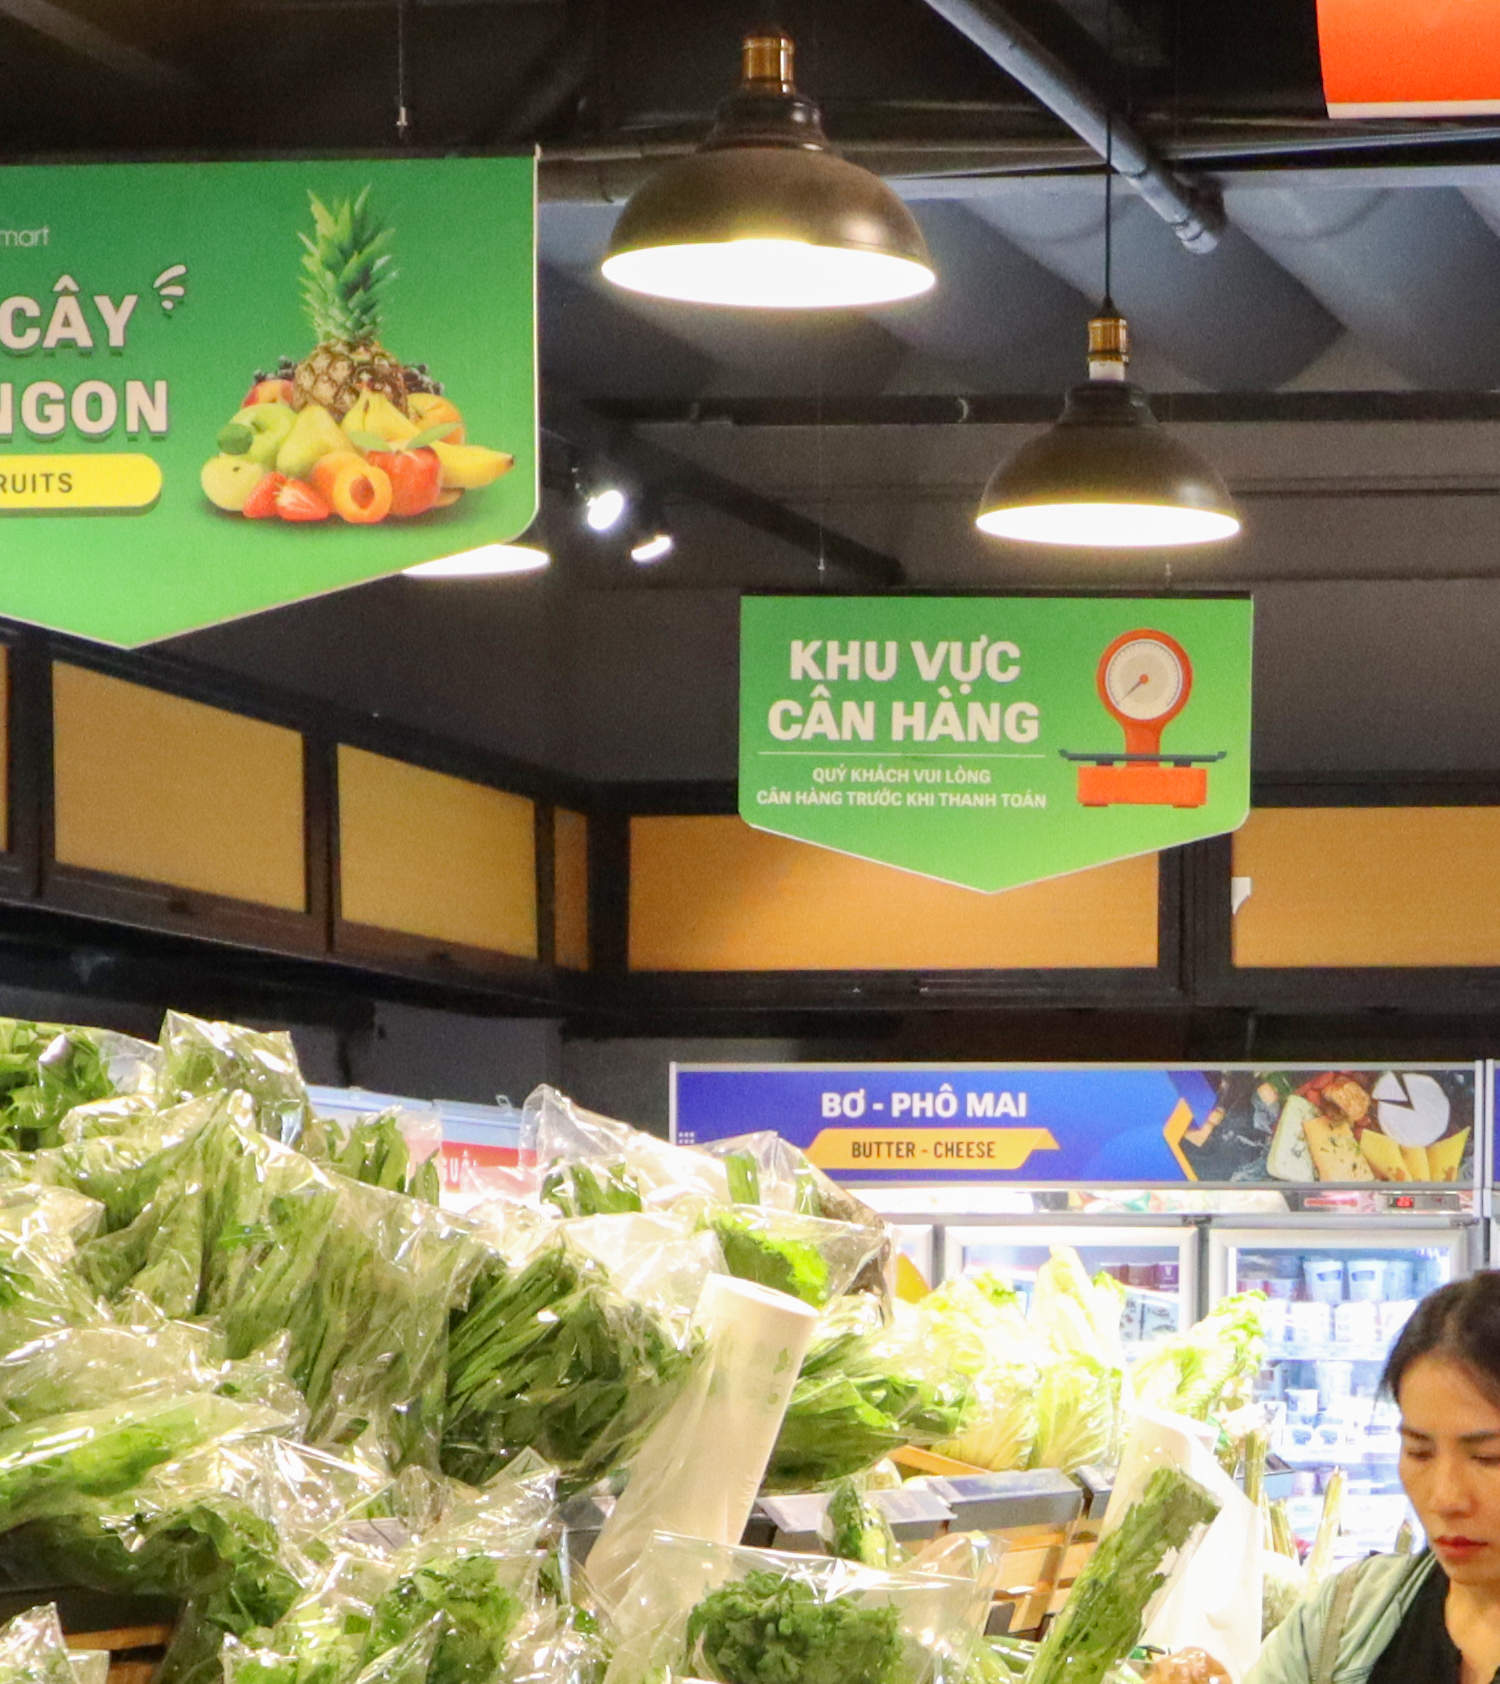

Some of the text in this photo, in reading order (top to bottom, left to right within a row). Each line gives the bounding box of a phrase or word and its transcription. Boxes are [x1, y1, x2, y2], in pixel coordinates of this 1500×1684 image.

[789, 634, 1021, 695] KHU VỰC
[767, 685, 1040, 744] CÂN HÀNG
[812, 764, 991, 785] QUÝ KHÁCH VUI LÒNG
[756, 787, 1047, 809] CÂN HÀNG TRƯỚC KHI THANH TOÁN
[821, 1091, 866, 1118] BƠ
[891, 1084, 959, 1118] PHÔ
[965, 1093, 1028, 1119] MAI
[851, 1141, 913, 1159] BUTTER
[934, 1141, 997, 1159] CHEESE
